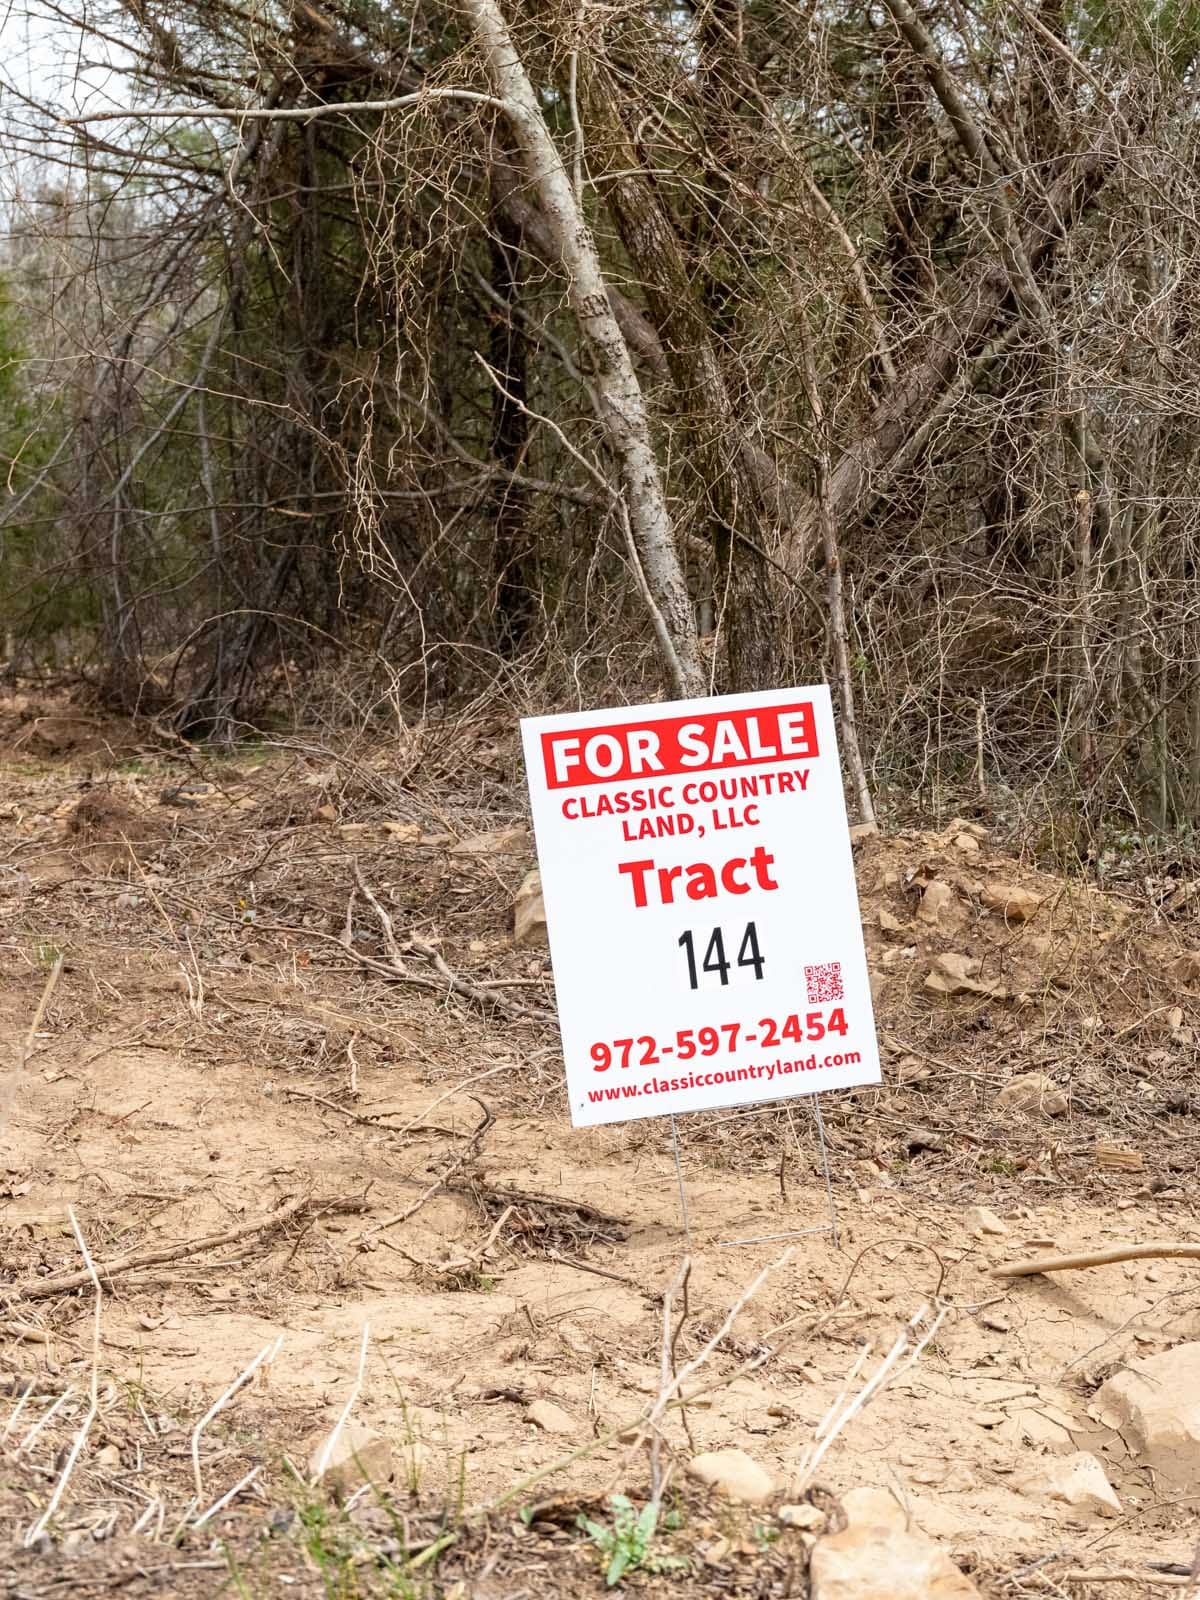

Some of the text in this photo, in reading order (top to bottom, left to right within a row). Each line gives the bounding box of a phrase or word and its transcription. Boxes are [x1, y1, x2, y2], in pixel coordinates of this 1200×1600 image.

[551, 711, 809, 783] FOR SALE
[561, 769, 811, 820] CLASSIC COUNTRY
[621, 804, 761, 842] LAND, LLC
[618, 846, 779, 908] Tract
[678, 921, 765, 990] 144
[589, 1008, 849, 1072] 972-597-2454
[588, 1049, 861, 1103] www.classiccountryland.com
